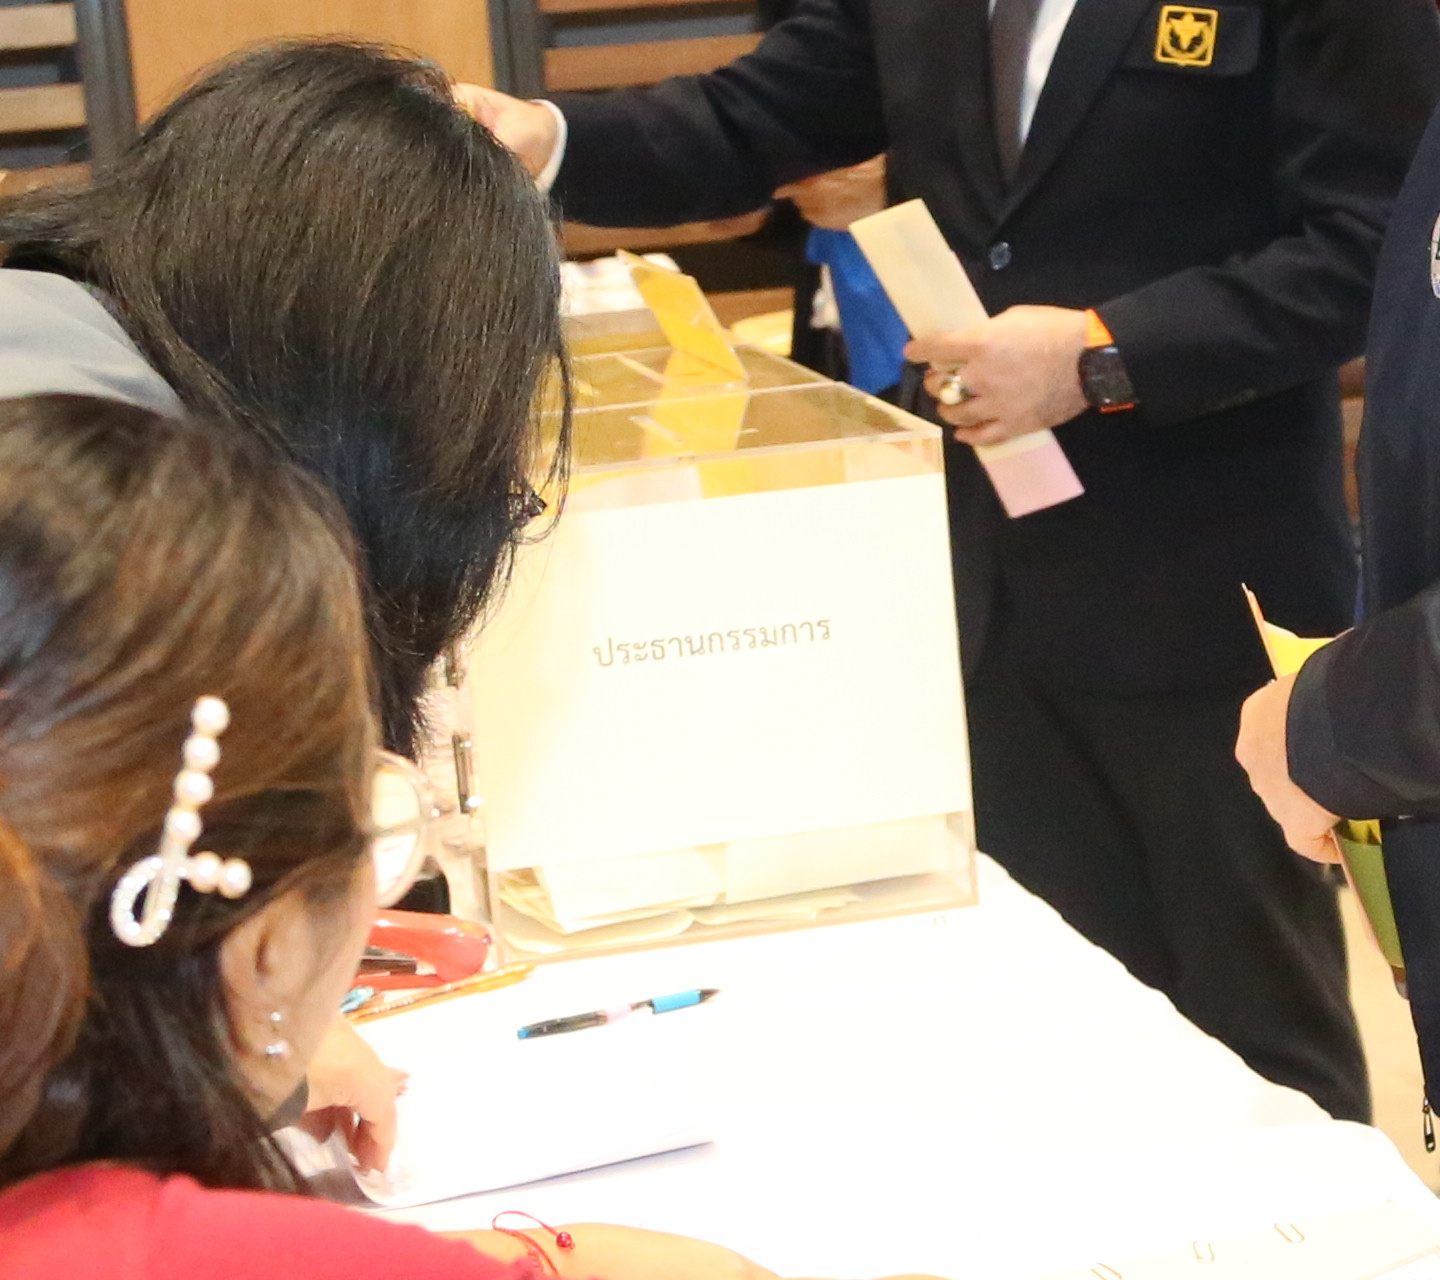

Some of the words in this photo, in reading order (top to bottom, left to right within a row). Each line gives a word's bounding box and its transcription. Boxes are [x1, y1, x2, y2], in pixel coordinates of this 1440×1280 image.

[592, 618, 831, 667] ประธานกรรมการ
